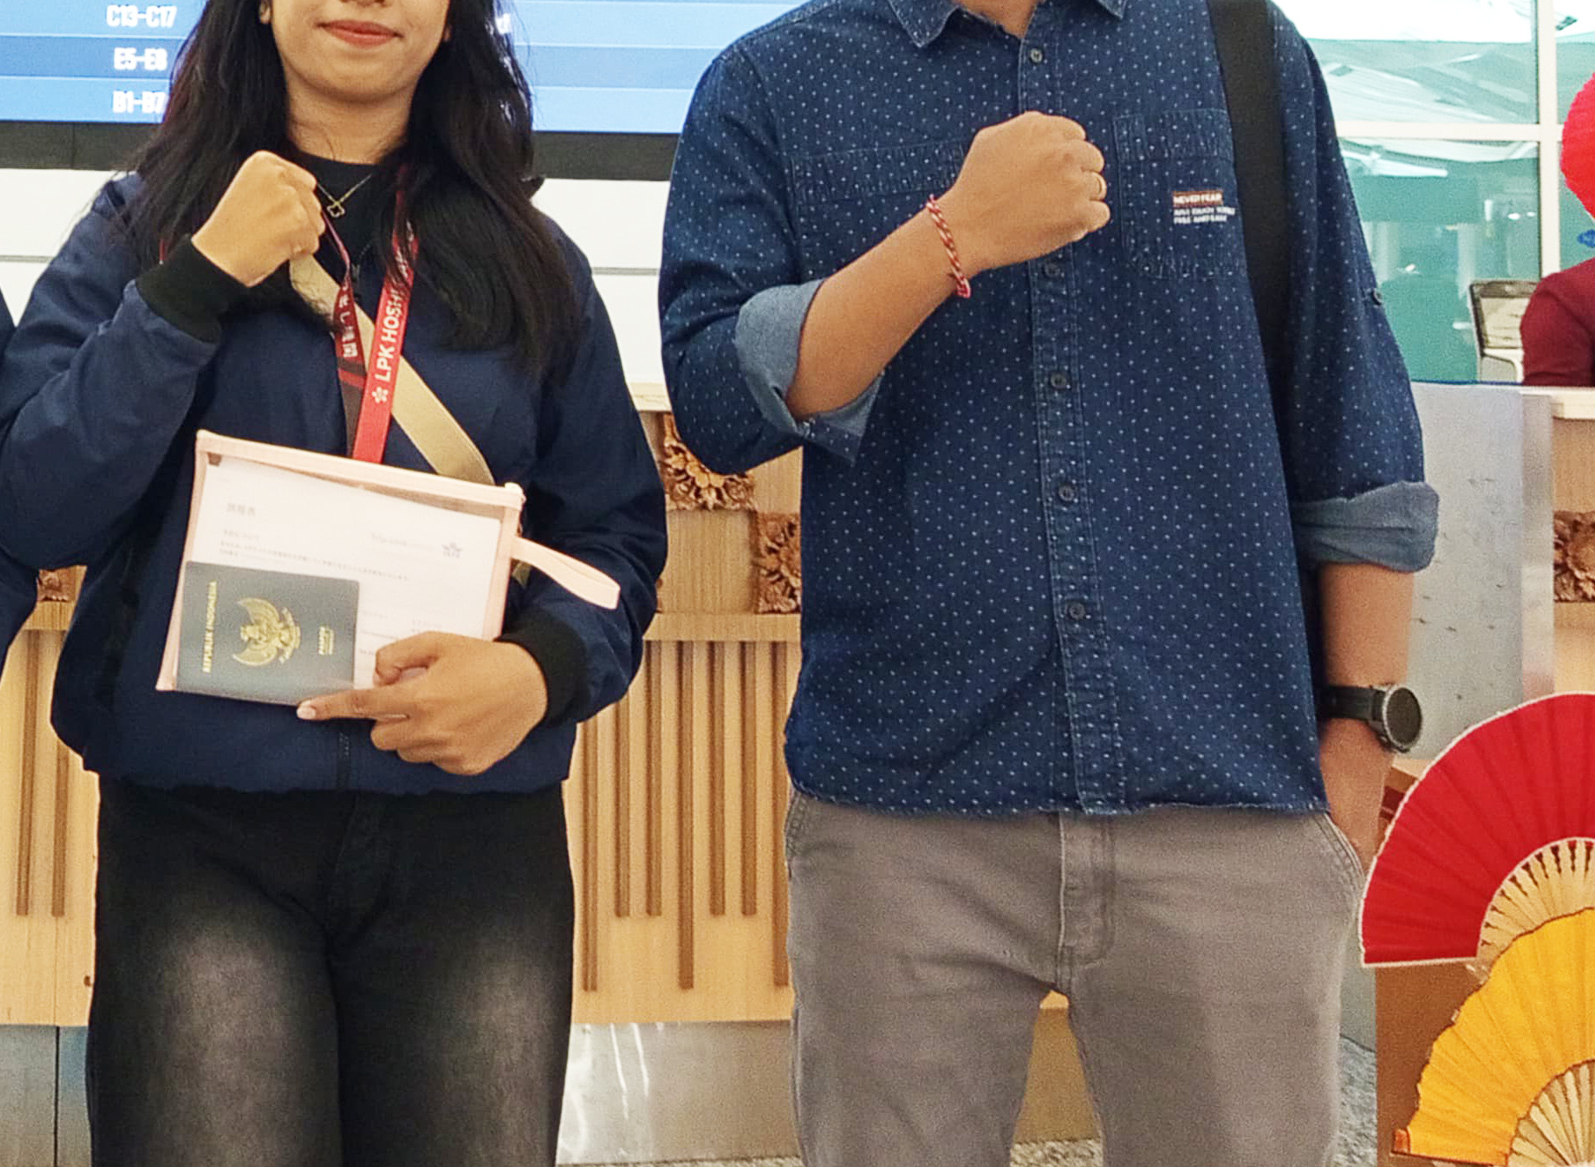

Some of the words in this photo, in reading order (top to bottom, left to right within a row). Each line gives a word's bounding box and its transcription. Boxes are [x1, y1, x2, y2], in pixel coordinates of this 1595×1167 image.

[107, 6, 178, 28] C13-C17
[375, 343, 395, 382] LPK
[206, 581, 217, 631] INDONESIA
